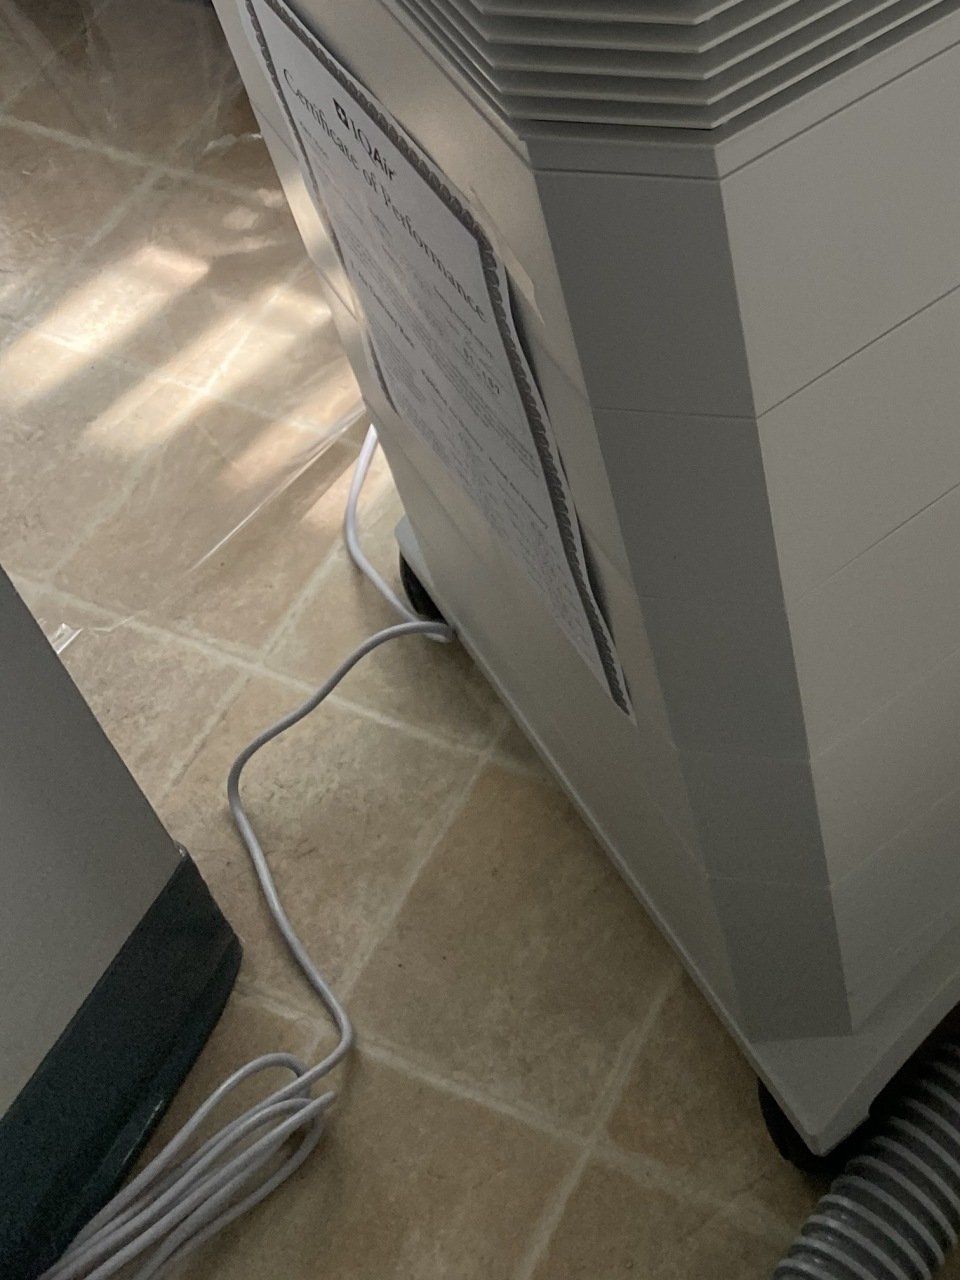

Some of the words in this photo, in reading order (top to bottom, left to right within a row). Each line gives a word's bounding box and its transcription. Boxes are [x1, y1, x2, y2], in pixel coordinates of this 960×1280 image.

[283, 68, 361, 171] Certificate
[362, 167, 379, 195] of
[379, 183, 487, 324] Performance
[348, 117, 397, 182] IQAir
